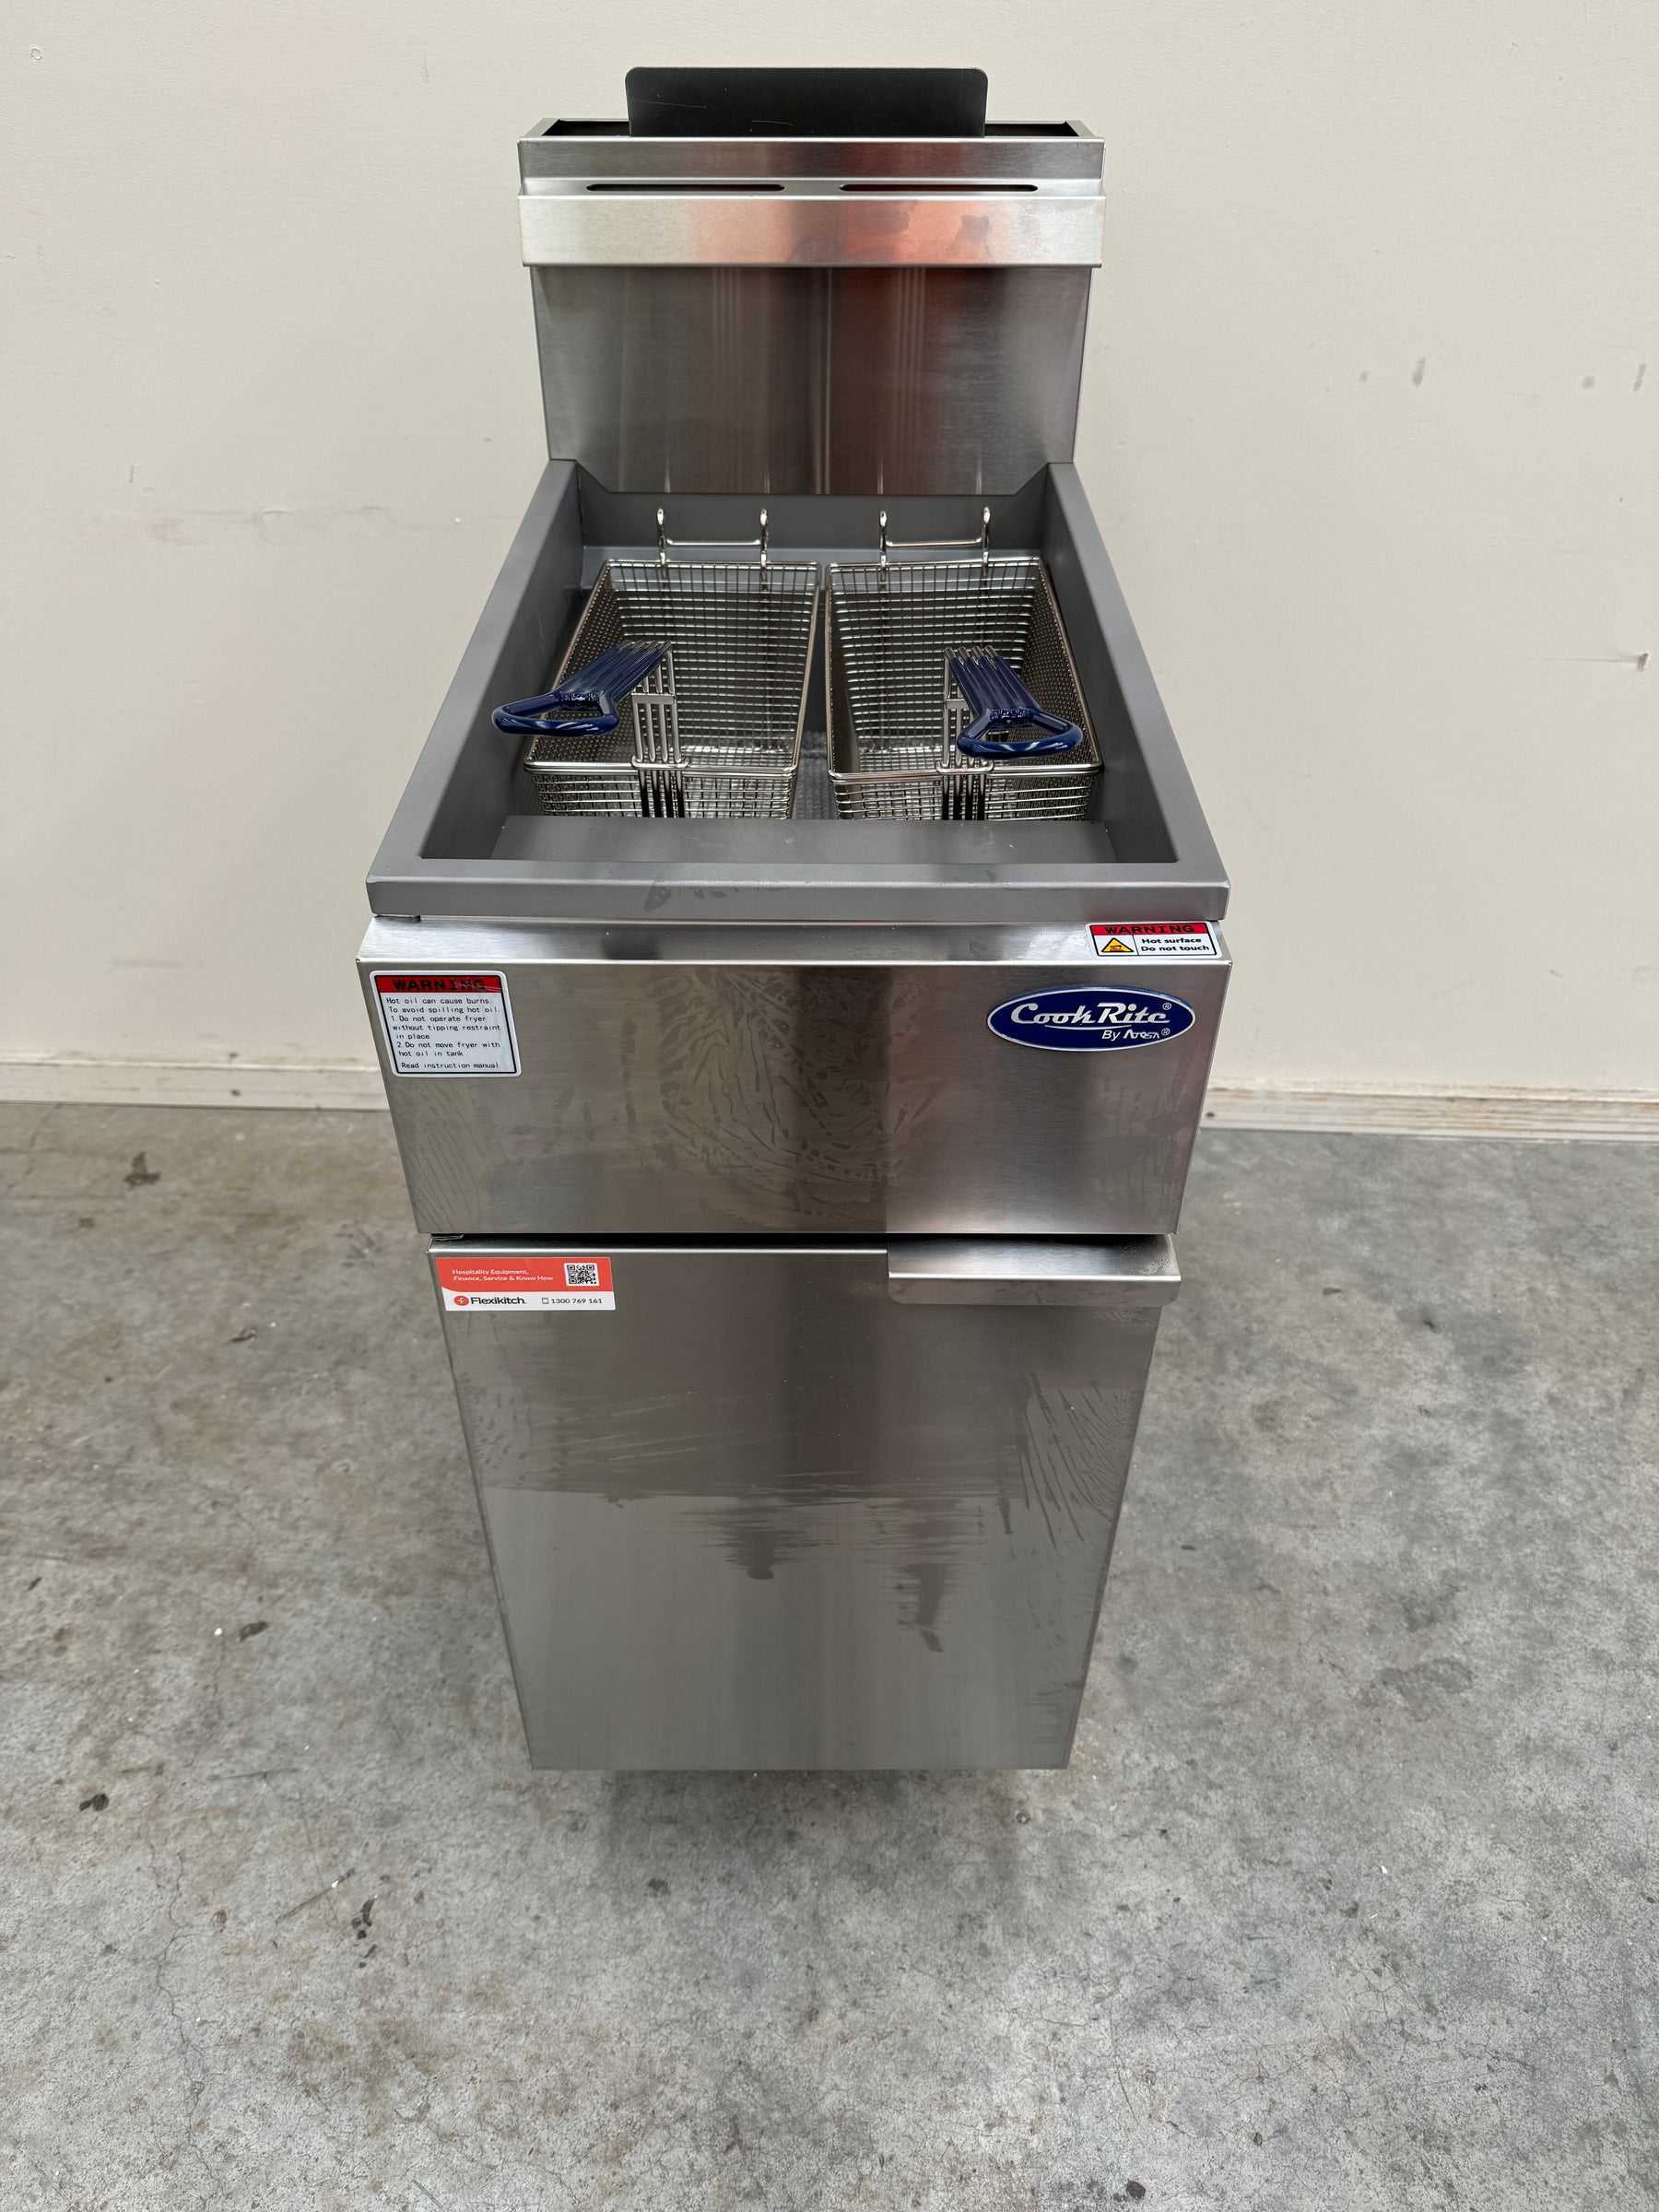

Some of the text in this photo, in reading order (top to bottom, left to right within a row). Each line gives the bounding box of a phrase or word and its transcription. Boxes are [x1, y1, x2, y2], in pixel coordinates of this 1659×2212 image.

[1105, 924, 1195, 934] WARNING
[393, 979, 486, 992] WARNING
[428, 1006, 465, 1014] spilling
[466, 1005, 481, 1013] hot
[429, 1015, 461, 1023] operate
[465, 1015, 487, 1023] fryer
[407, 1032, 430, 1041] place
[1101, 1030, 1121, 1041] By
[424, 1061, 471, 1069] instruction
